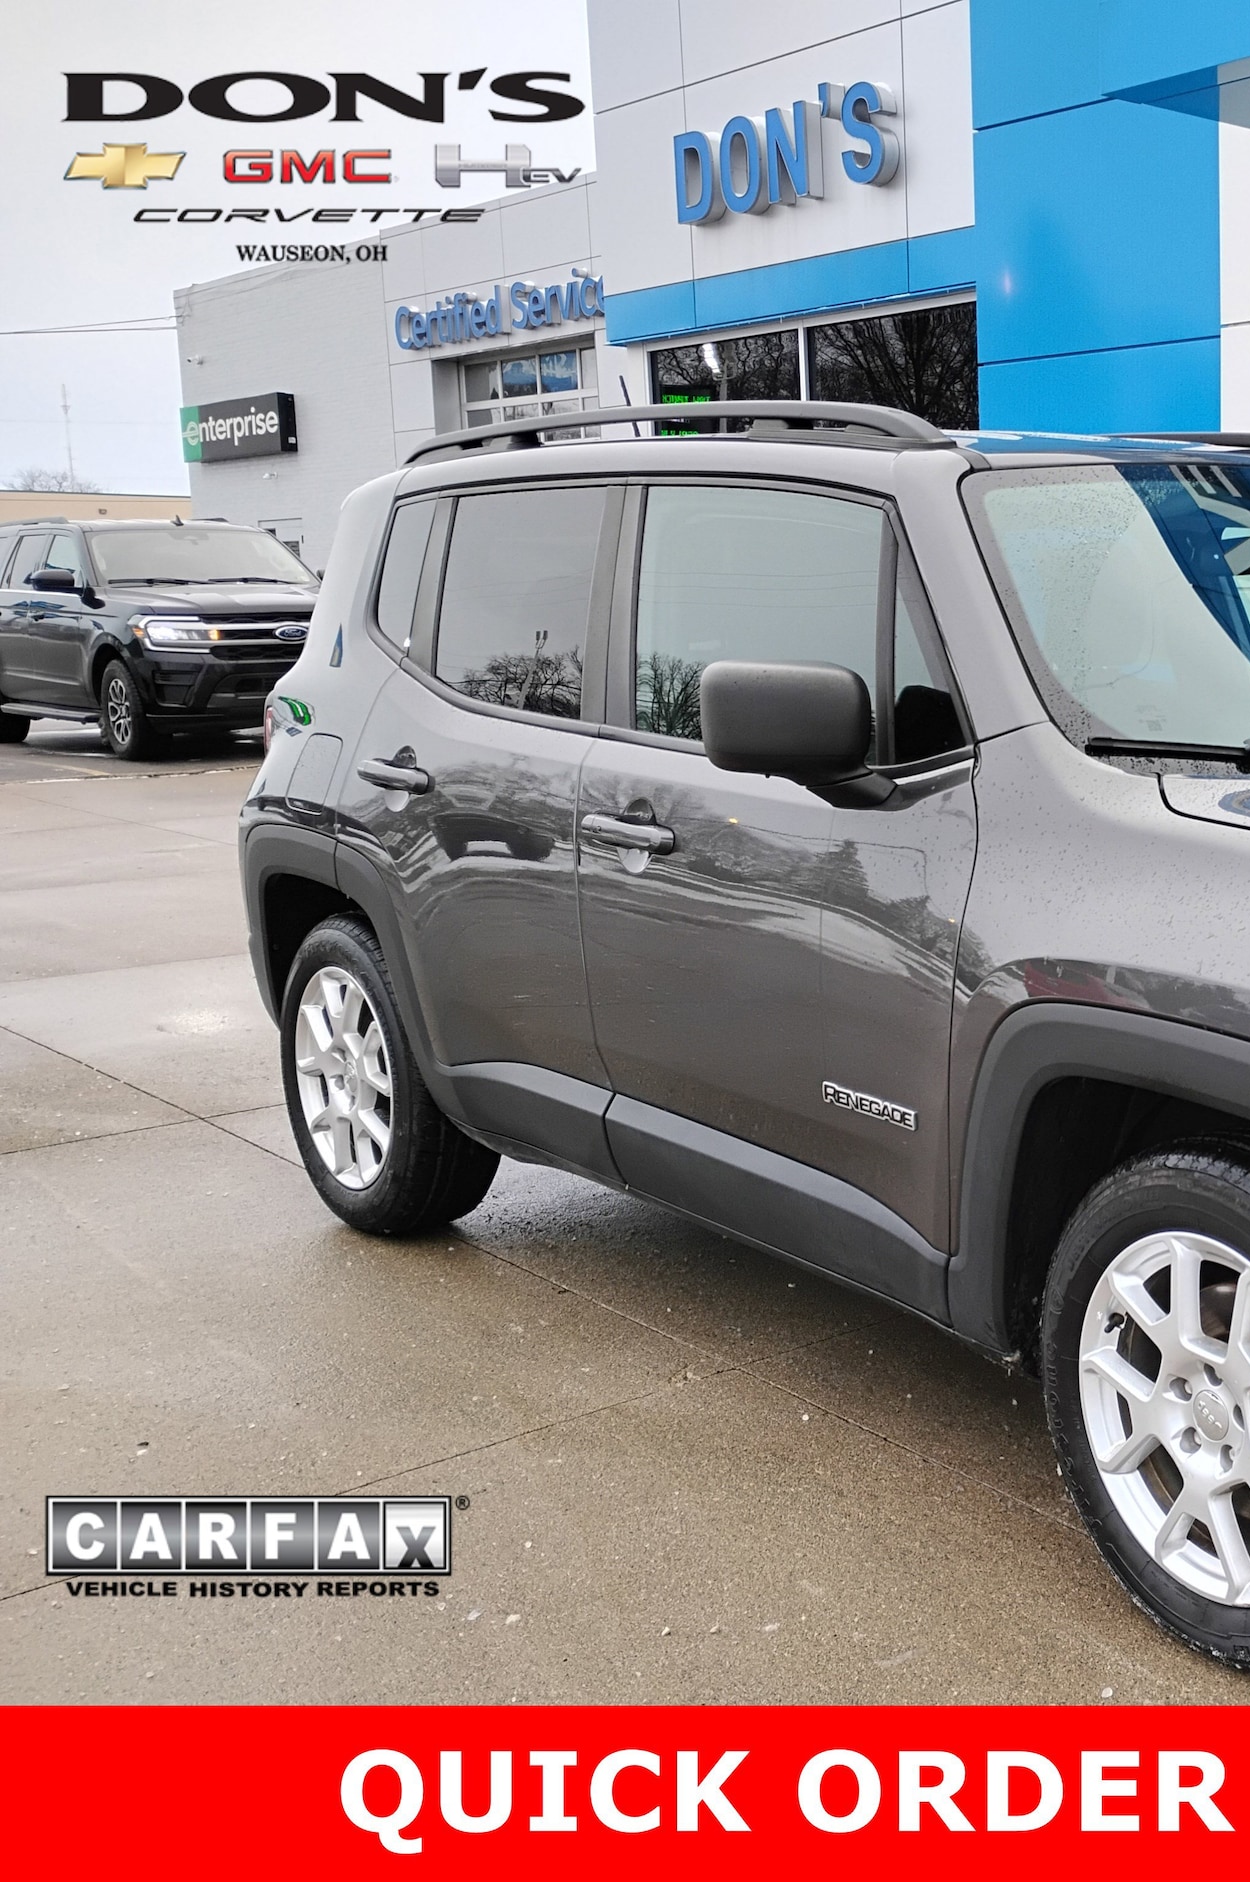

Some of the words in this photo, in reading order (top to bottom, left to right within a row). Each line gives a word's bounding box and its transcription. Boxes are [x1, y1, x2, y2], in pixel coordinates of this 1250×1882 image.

[673, 81, 899, 225] DON'S
[395, 285, 509, 350] Certified
[182, 406, 279, 446] enterprise
[822, 1081, 917, 1131] RENEGADE
